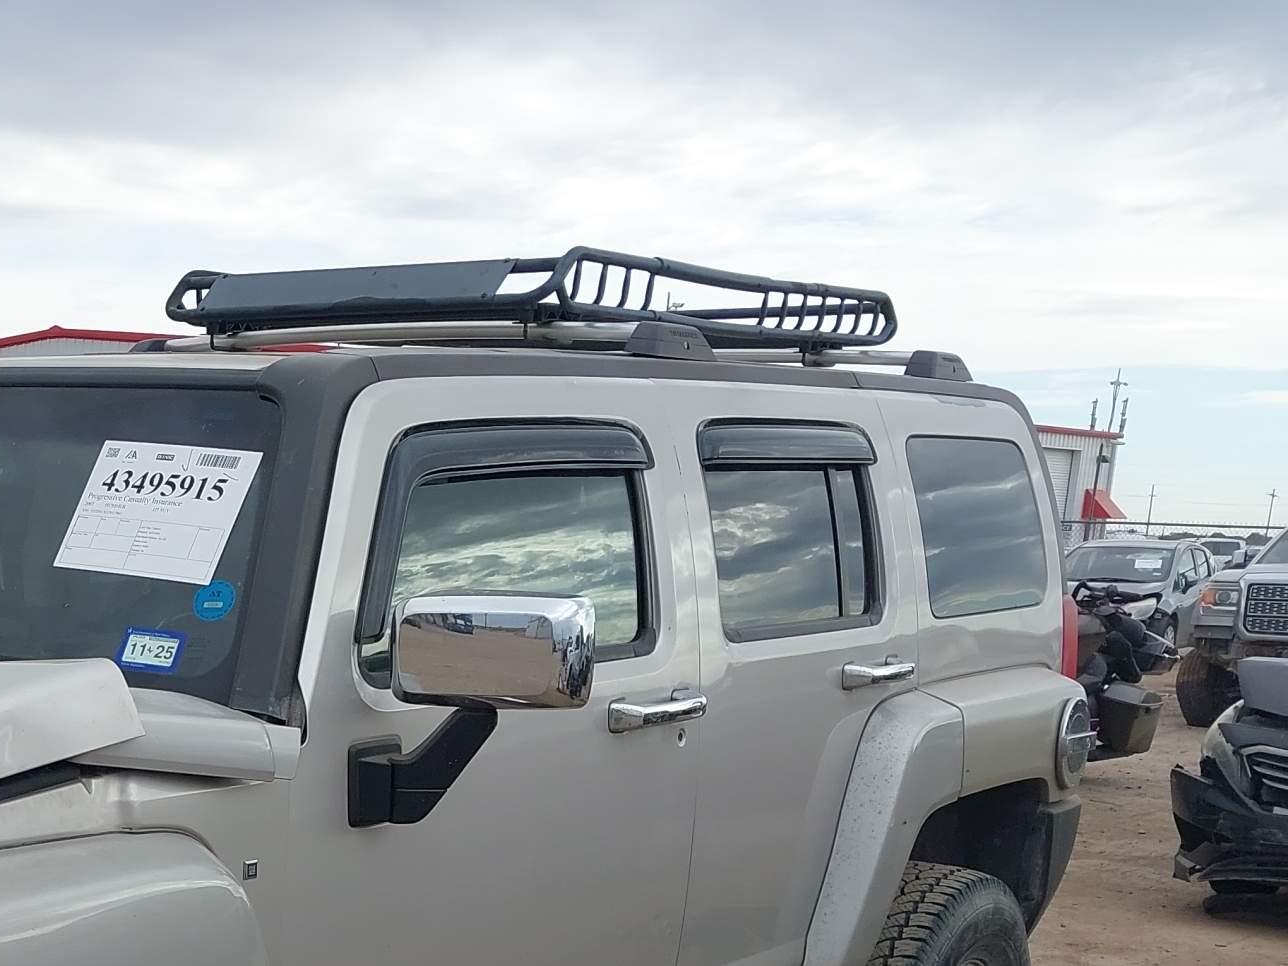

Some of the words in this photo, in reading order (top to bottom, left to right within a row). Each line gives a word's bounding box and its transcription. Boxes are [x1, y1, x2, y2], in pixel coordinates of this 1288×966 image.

[102, 469, 229, 501] 43495915
[87, 492, 123, 502] Progressive
[152, 498, 183, 507] Insurance
